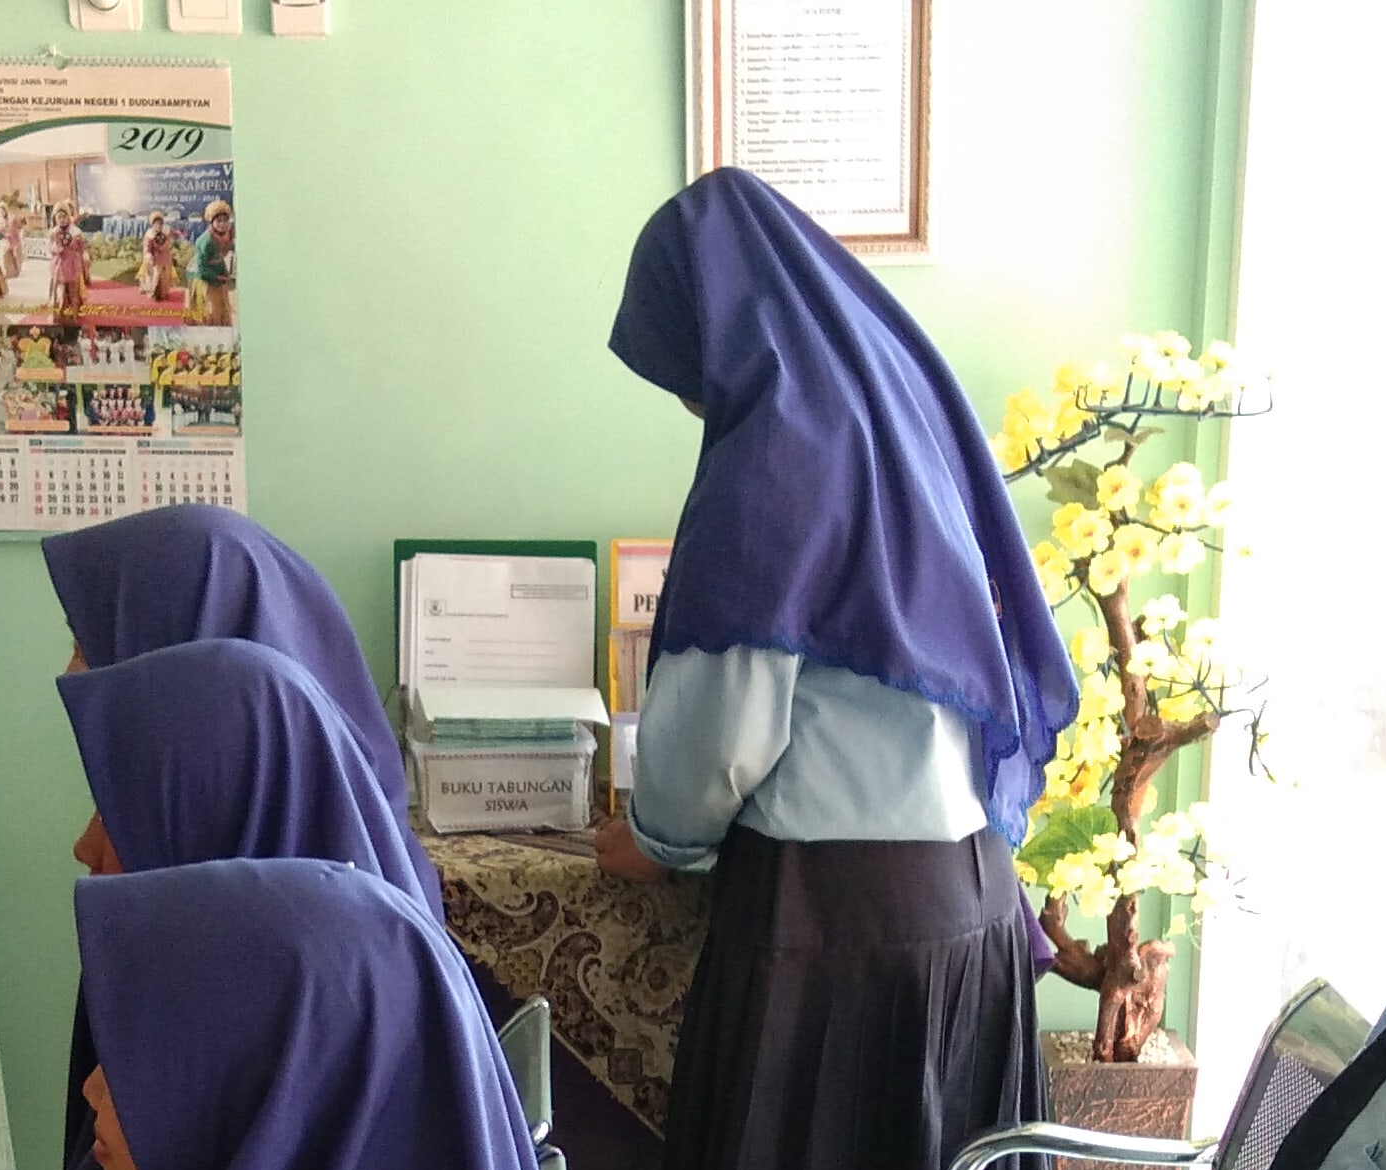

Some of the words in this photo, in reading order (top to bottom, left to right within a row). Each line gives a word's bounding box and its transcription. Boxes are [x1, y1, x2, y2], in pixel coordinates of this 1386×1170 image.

[31, 96, 81, 107] KEJURUAN
[84, 97, 118, 106] NEGERI
[129, 97, 210, 108] DUDUKSAMPEYAN
[114, 127, 204, 160] 2019
[441, 782, 483, 795] BUKU
[487, 780, 573, 795] TABUNGAN
[485, 800, 529, 812] SISWA
